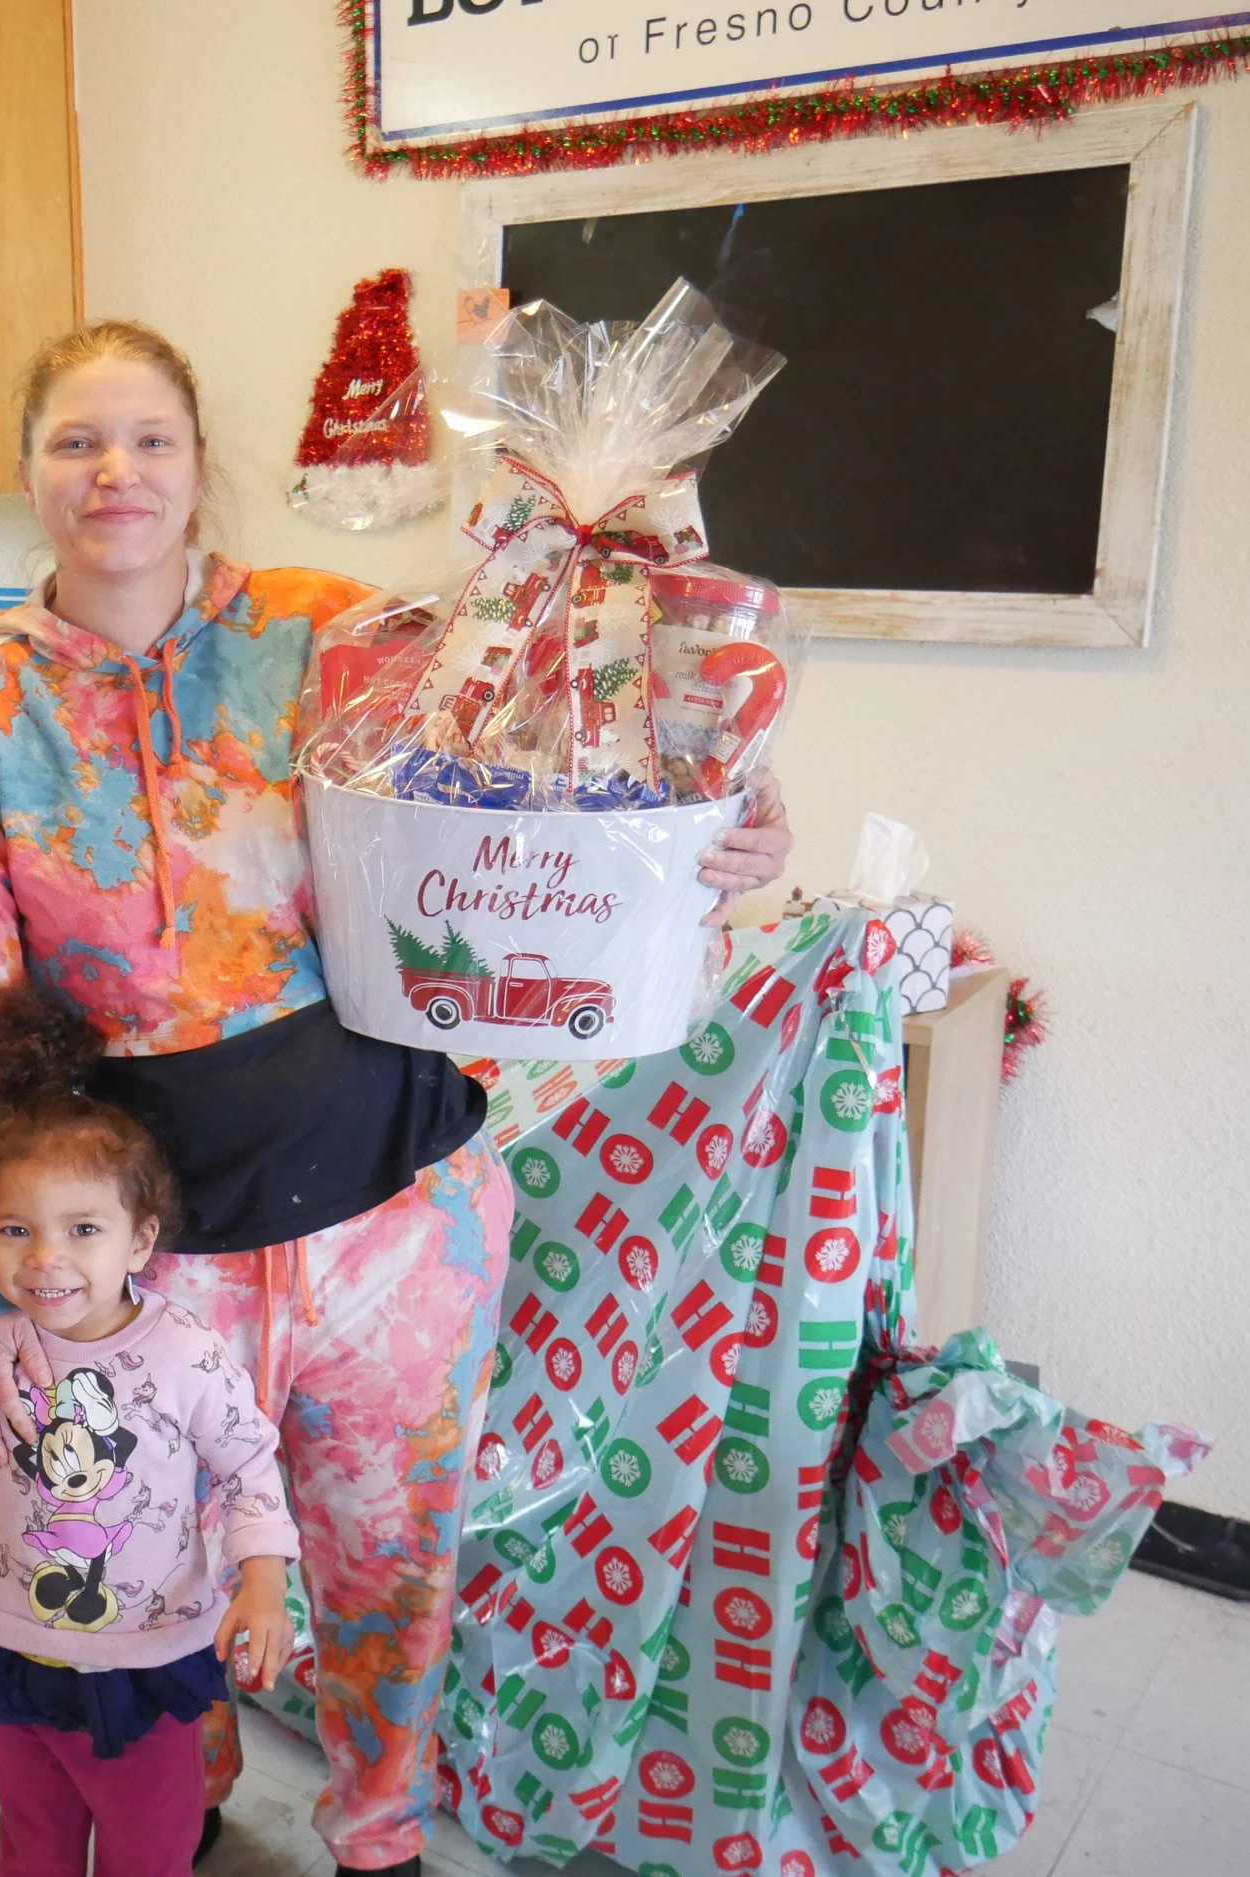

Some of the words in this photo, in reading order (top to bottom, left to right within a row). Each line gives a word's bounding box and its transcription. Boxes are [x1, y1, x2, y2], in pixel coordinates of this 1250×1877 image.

[644, 2, 812, 54] Fresno
[342, 378, 383, 400] Merry
[472, 834, 581, 889] Merry
[416, 869, 624, 924] Christmas
